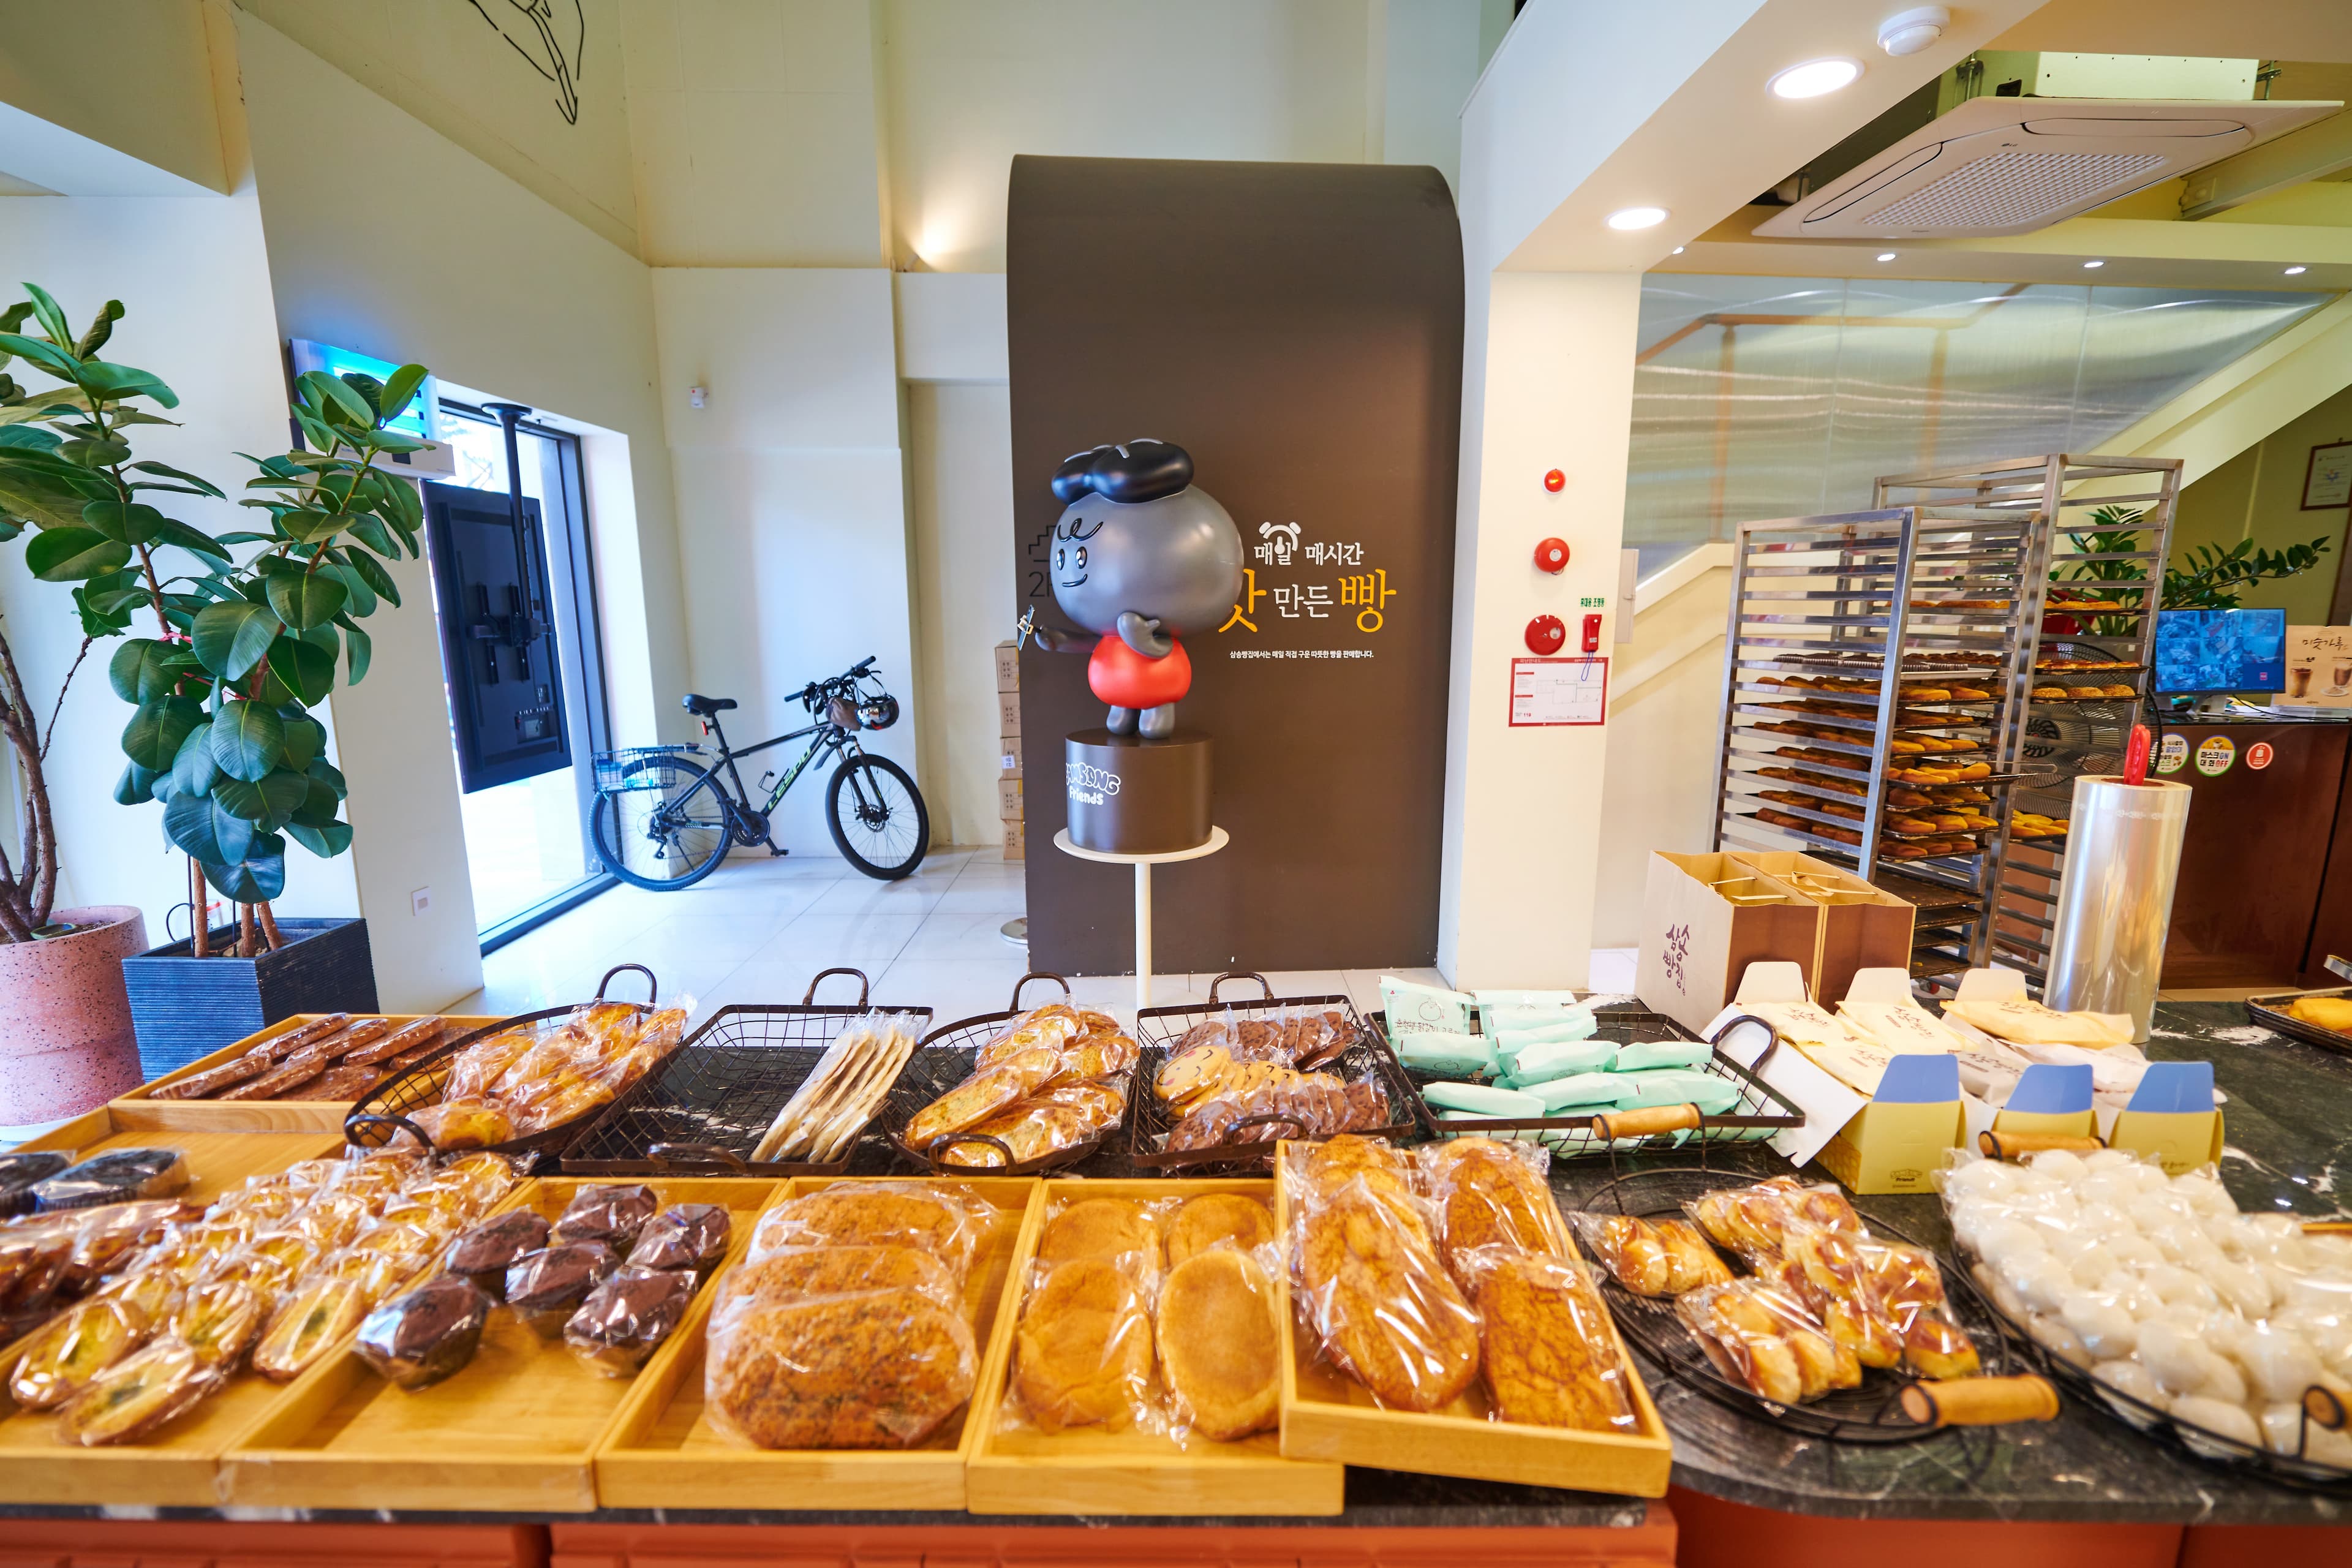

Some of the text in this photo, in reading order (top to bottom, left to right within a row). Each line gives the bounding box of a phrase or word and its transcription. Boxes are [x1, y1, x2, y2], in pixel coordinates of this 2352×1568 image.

[1254, 537, 1365, 566] 매일 매시간
[1273, 584, 1334, 618] 만든
[1338, 568, 1397, 633] 빵
[2302, 636, 2344, 650] 미숫가루
[1229, 650, 1374, 659] 삼송빵집에서는 매일 직접 구운 따뜻한 빵을 판매합니다.
